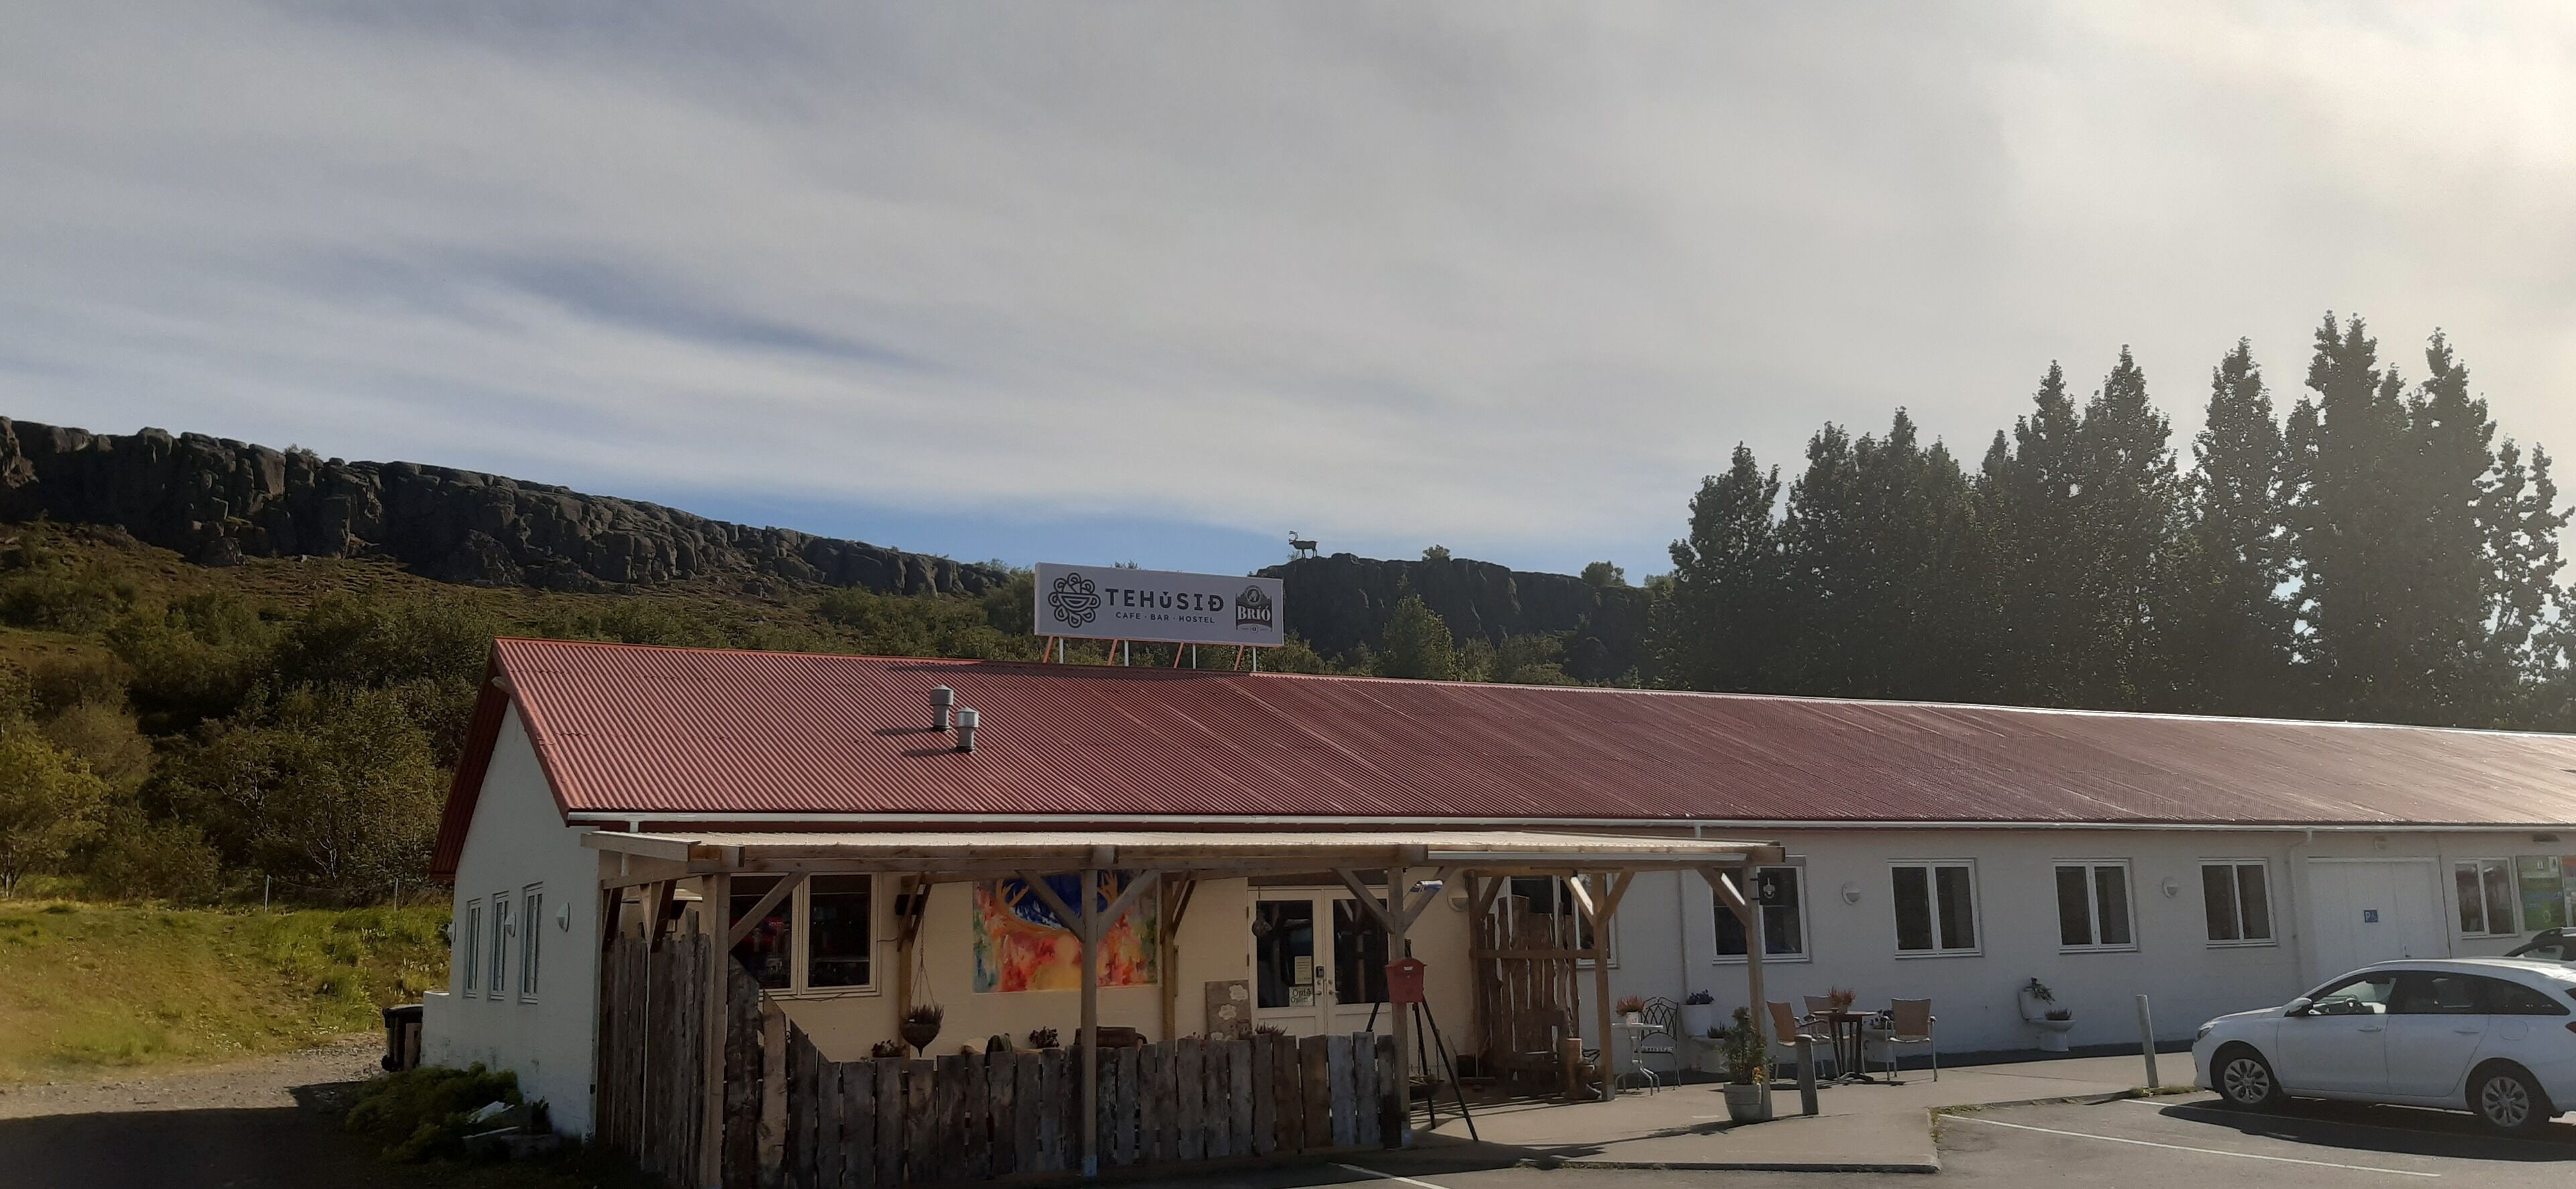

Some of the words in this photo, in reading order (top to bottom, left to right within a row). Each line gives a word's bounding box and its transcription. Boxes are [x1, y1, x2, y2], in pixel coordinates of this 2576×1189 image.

[1116, 612, 1141, 620] CAFE
[1179, 616, 1215, 624] HOSTEL
[2365, 912, 2370, 921] P
